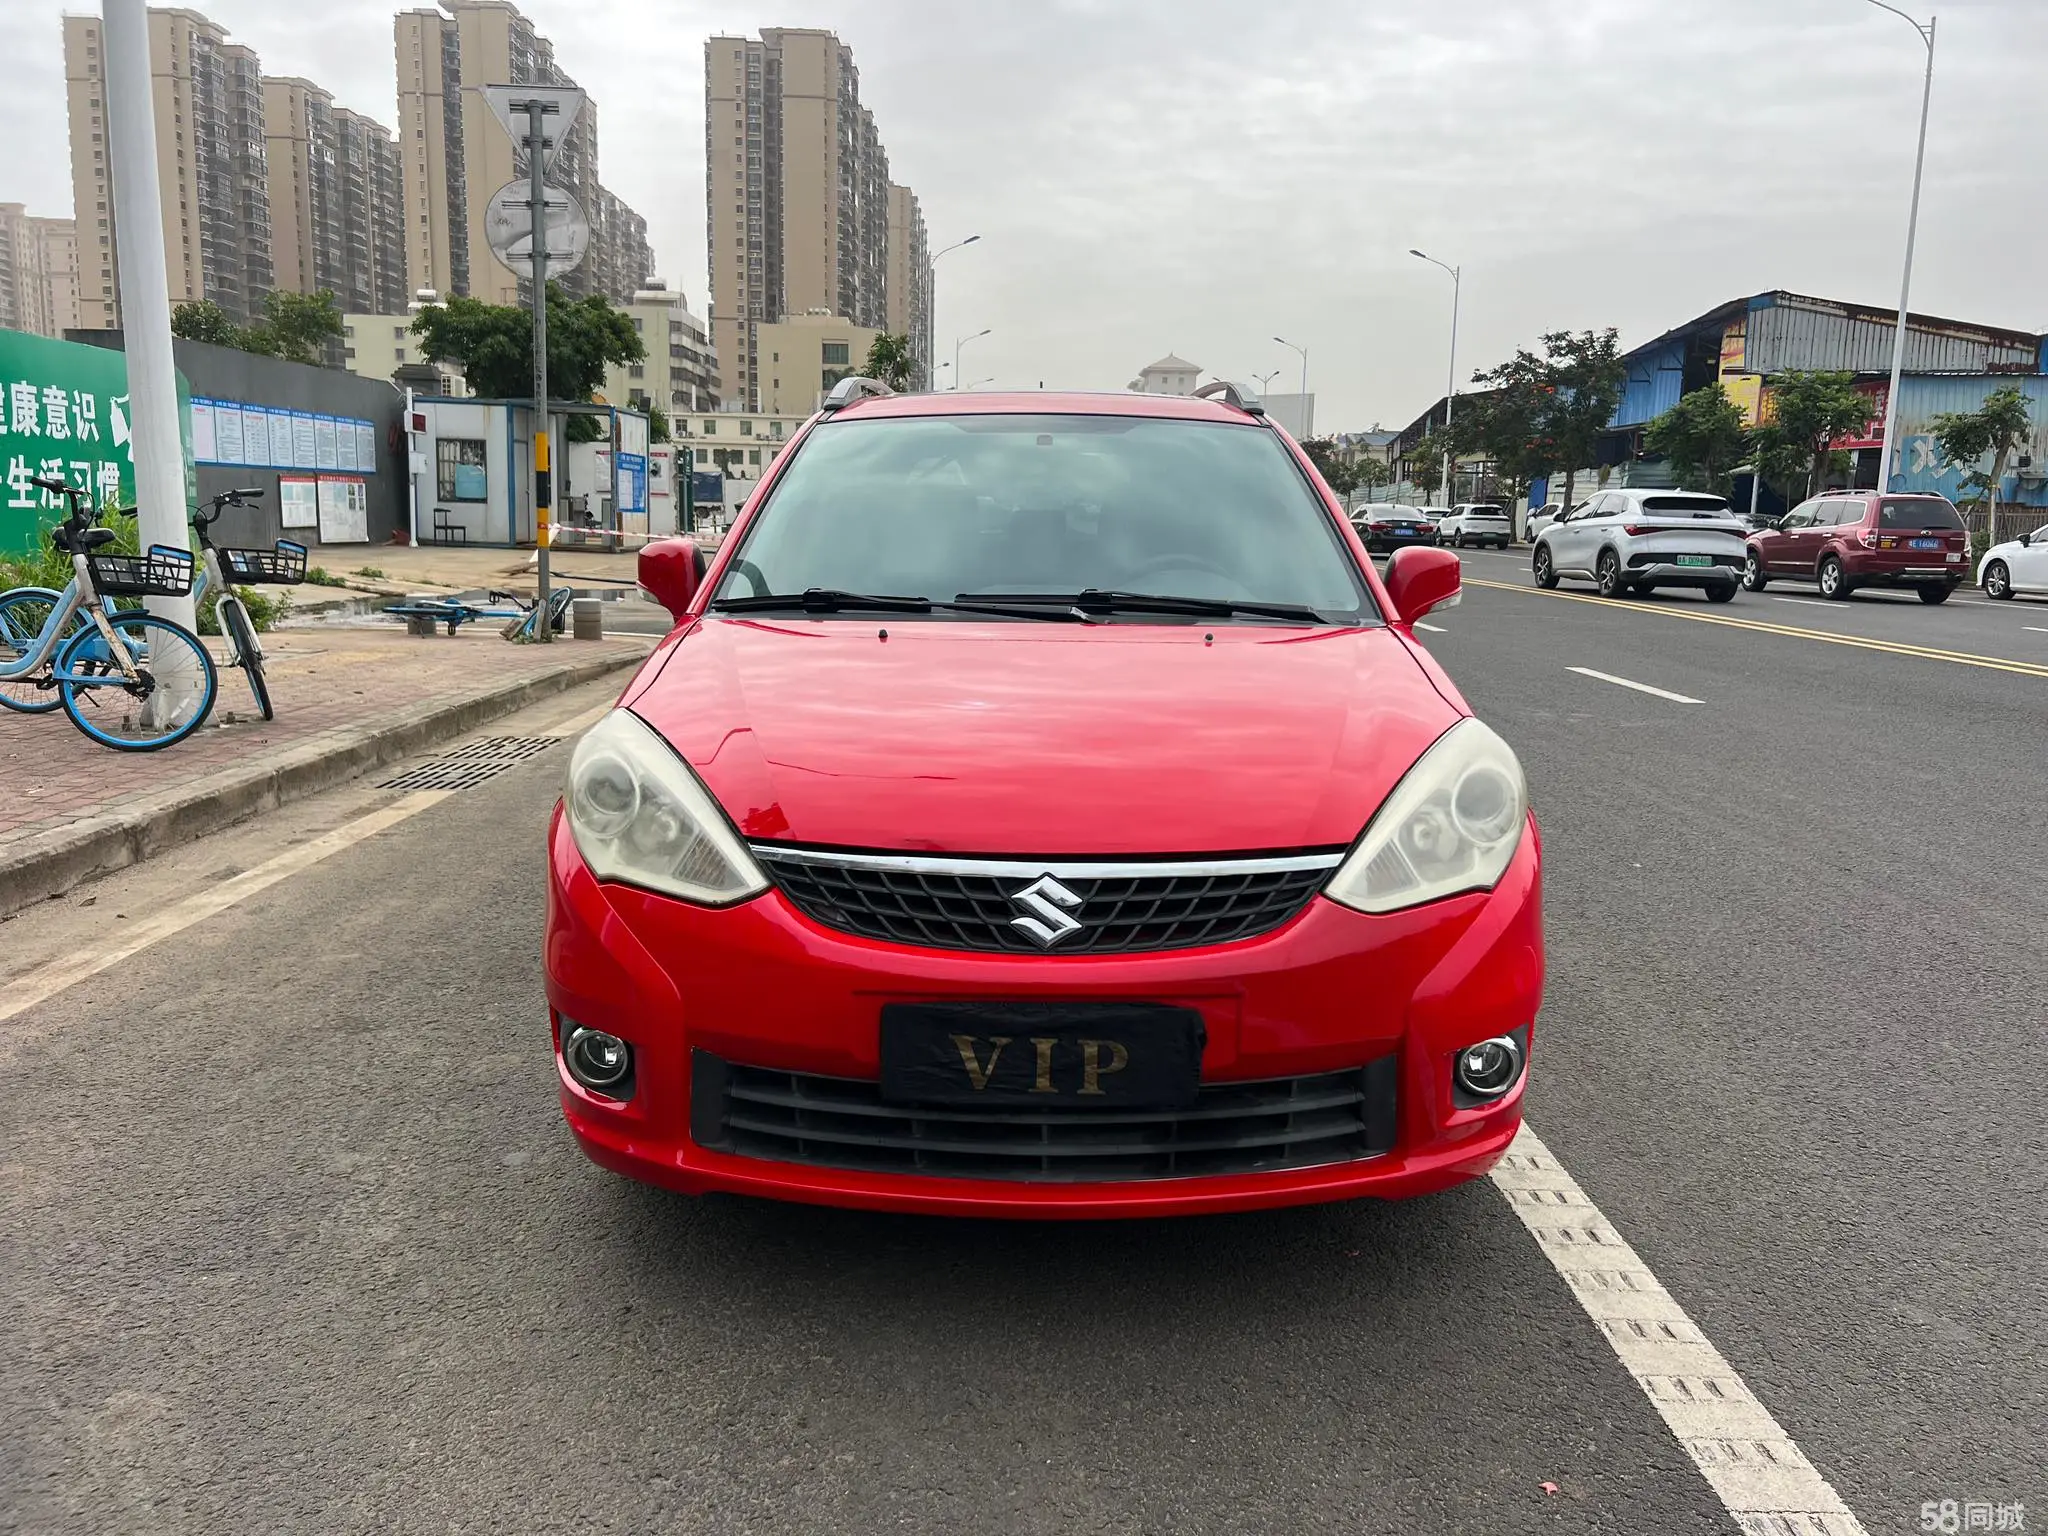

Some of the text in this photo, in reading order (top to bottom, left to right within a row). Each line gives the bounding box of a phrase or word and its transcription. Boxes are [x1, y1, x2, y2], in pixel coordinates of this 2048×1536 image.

[0, 380, 100, 441] 康意识
[0, 455, 120, 509] 生活习惯
[949, 1033, 1129, 1096] VIP
